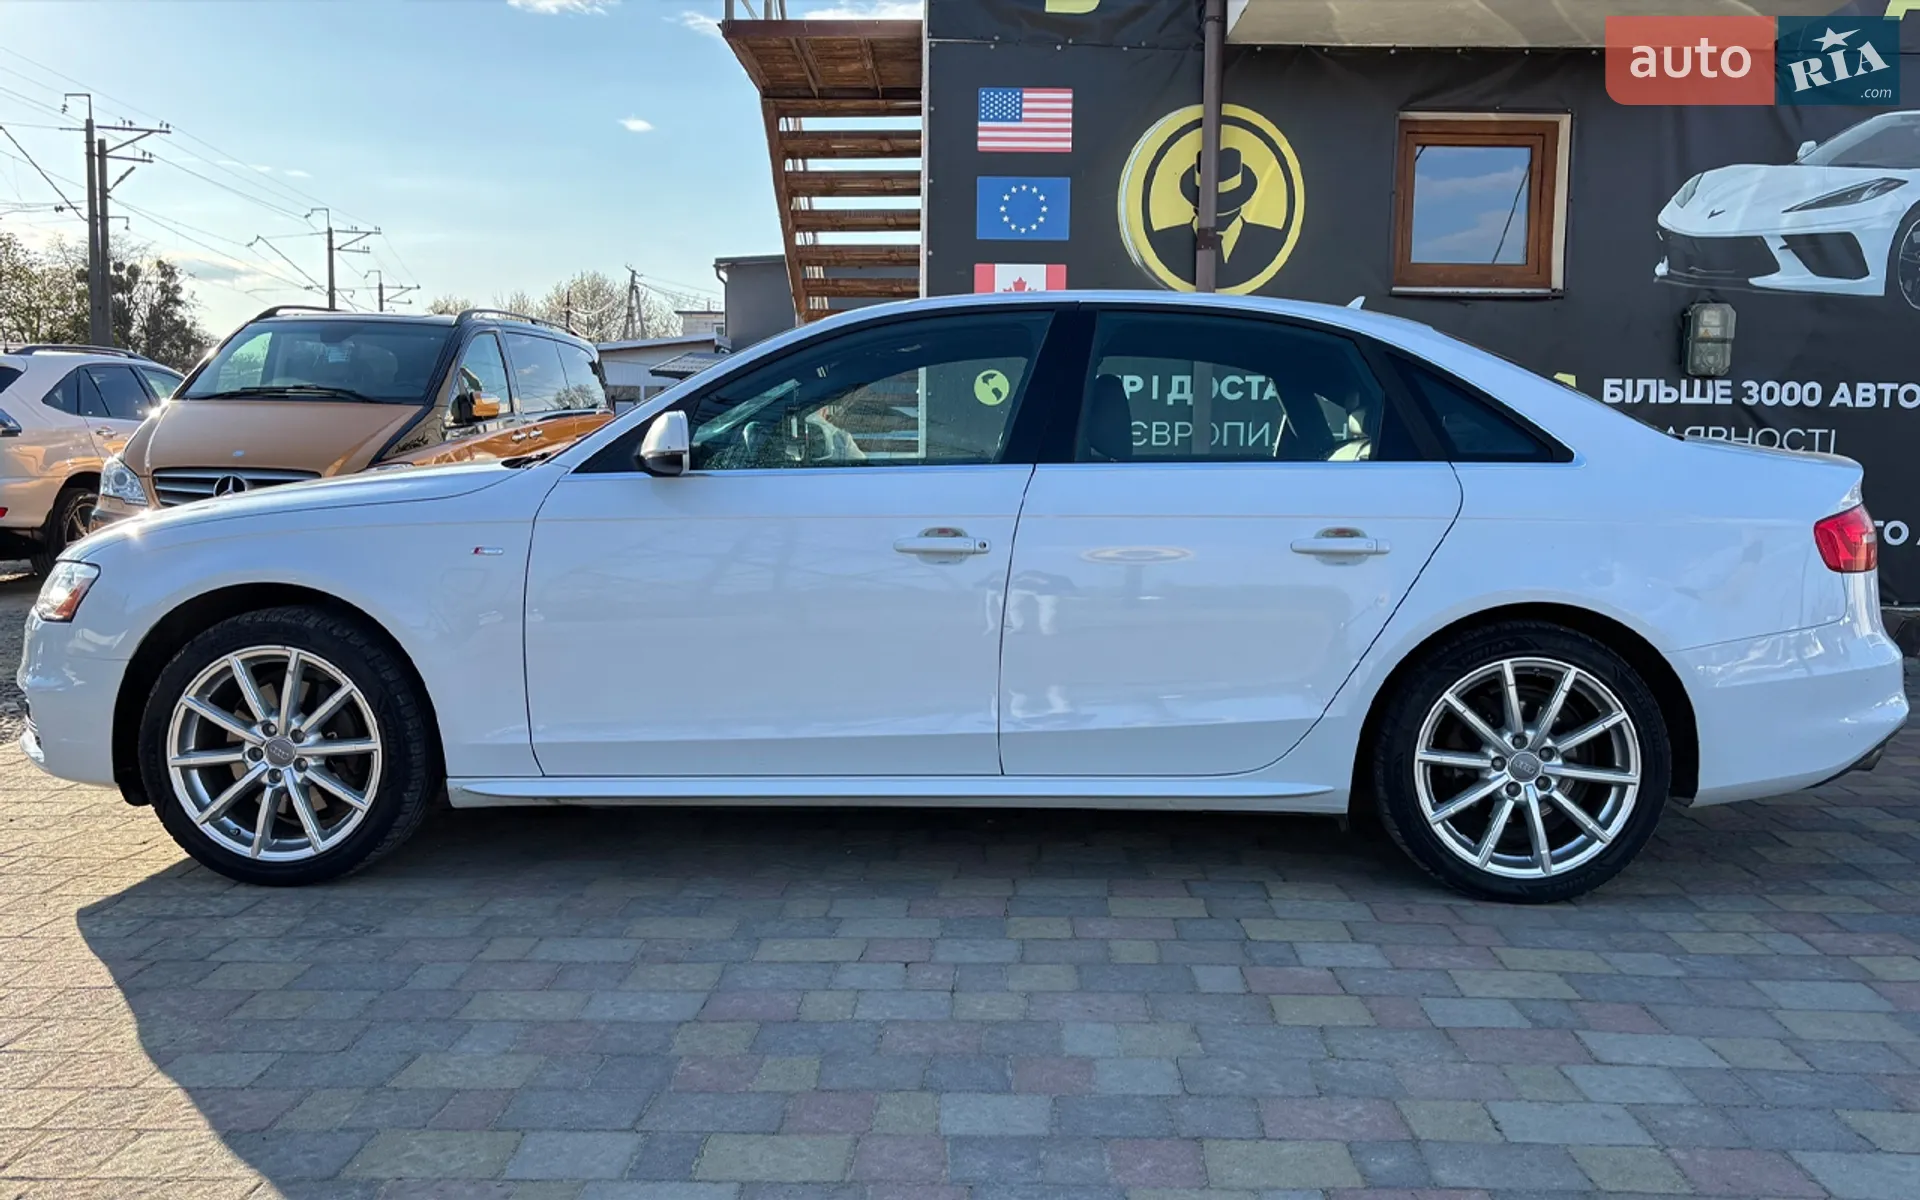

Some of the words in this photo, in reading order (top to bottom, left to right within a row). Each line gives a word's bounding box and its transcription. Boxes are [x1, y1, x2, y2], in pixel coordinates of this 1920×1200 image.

[1603, 378, 1732, 405] БІЛЬШЕ
[1741, 380, 1823, 407] 3000
[1828, 382, 1920, 409] АВТО
